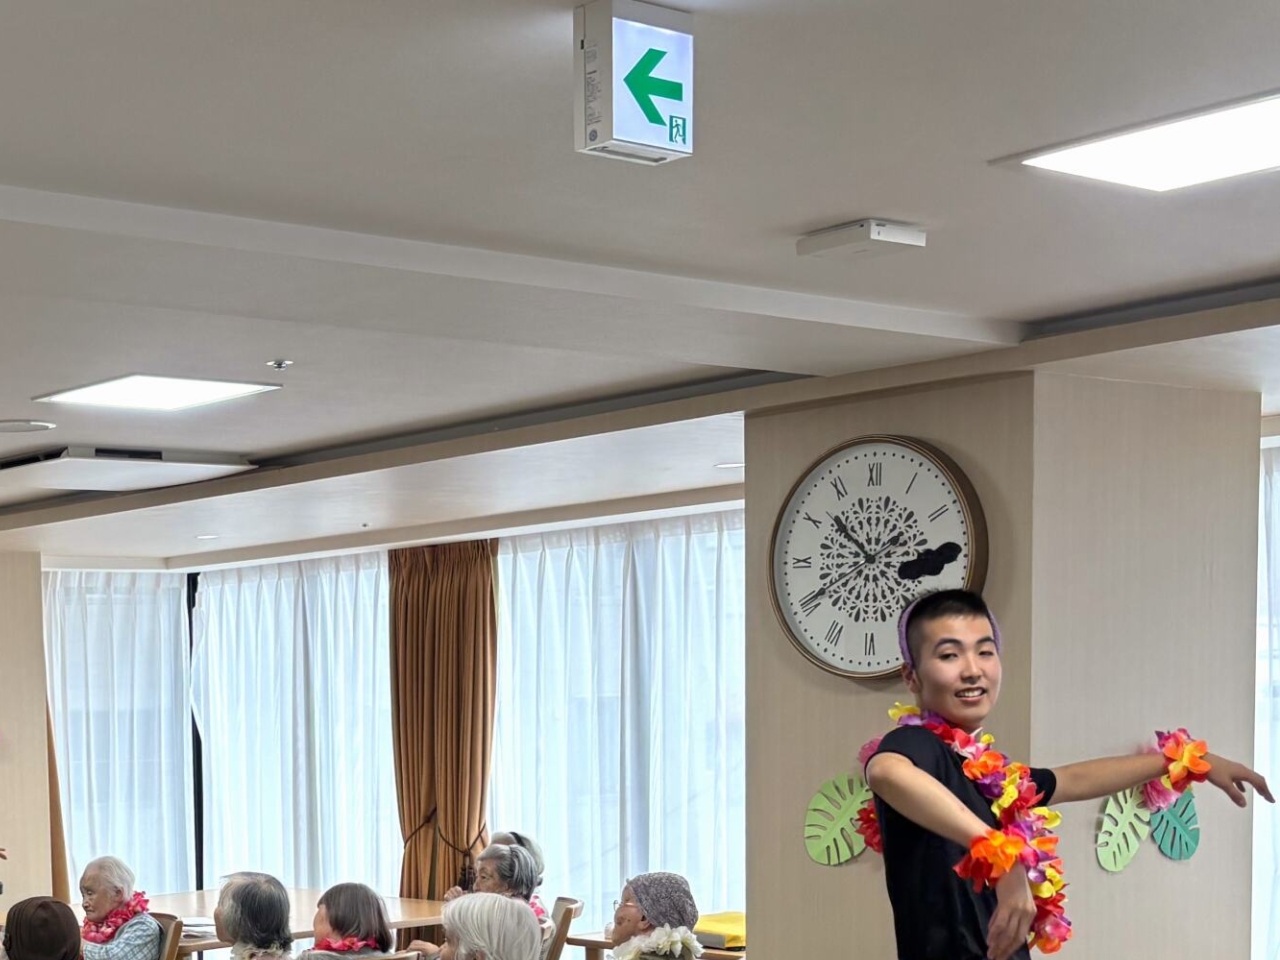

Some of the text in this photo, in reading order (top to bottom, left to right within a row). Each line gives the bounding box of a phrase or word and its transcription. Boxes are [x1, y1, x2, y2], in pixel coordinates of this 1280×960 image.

[867, 462, 882, 487] XII
[830, 475, 848, 501] XI
[803, 512, 822, 529] X
